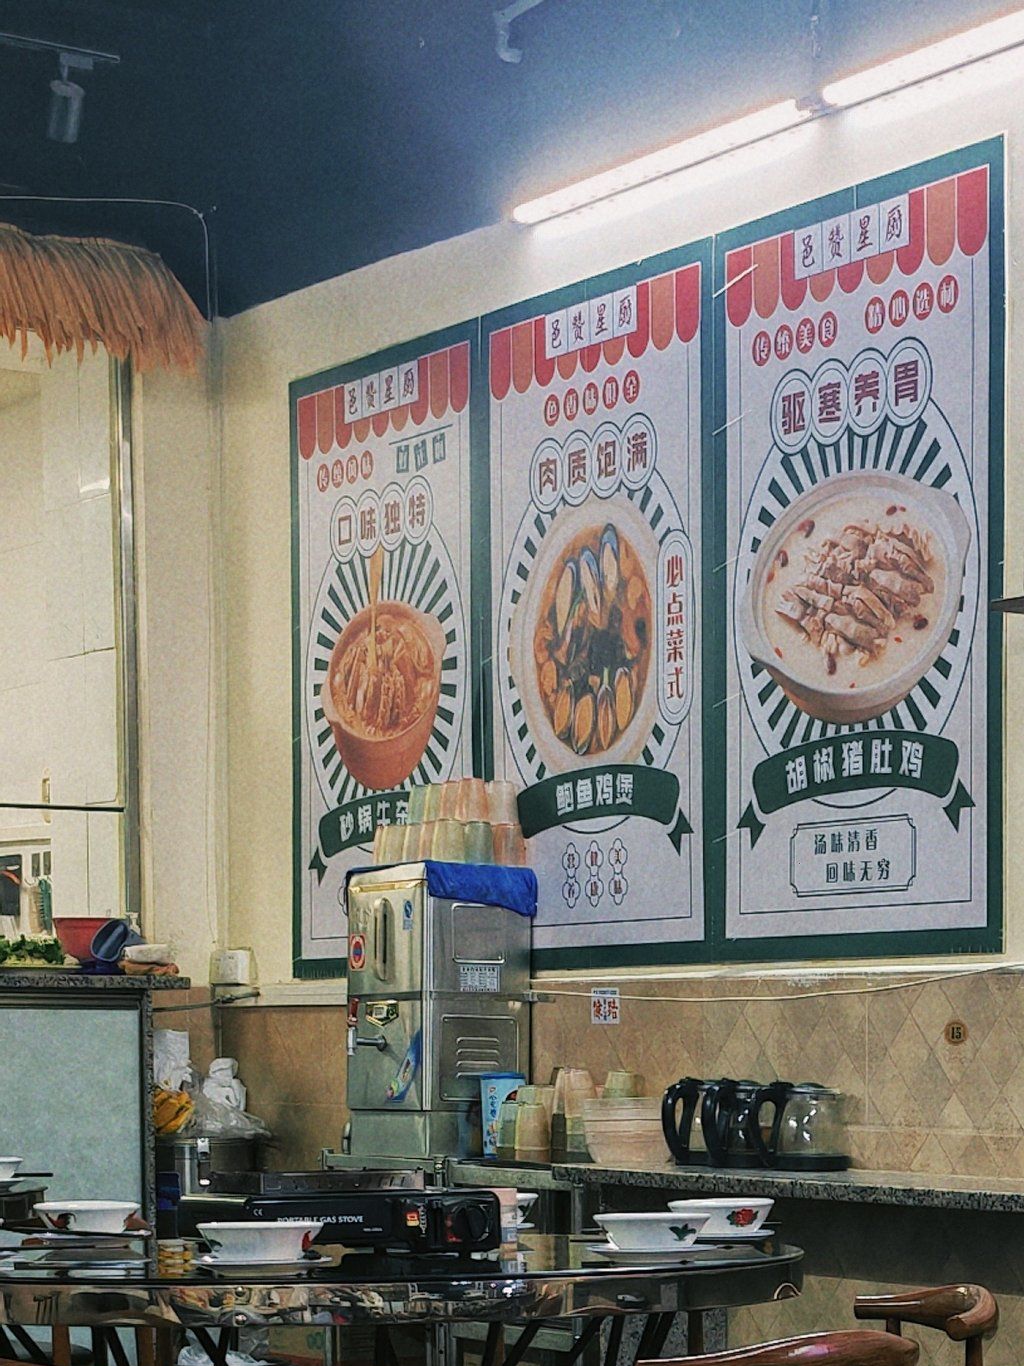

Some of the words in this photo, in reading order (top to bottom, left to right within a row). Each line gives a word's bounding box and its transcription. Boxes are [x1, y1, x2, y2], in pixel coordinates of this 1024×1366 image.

[801, 204, 903, 268] 邑赞星厨
[551, 294, 633, 349] 邑赞星厨
[754, 314, 837, 364] 传统美食
[348, 367, 415, 415] 邑赞星厨
[781, 359, 919, 435] 驱寒养胃
[539, 431, 647, 495] 肉质饱满
[338, 493, 426, 546] 口味独特
[666, 554, 684, 700] 必点菜式
[785, 738, 924, 794] 胡椒猪肚鸡
[556, 772, 634, 817] 鲍鱼鸡煲
[814, 828, 878, 856] 汤味清香
[826, 858, 890, 884] 回味无穷
[319, 1216, 337, 1224] GAS
[338, 1215, 364, 1224] STOVE
